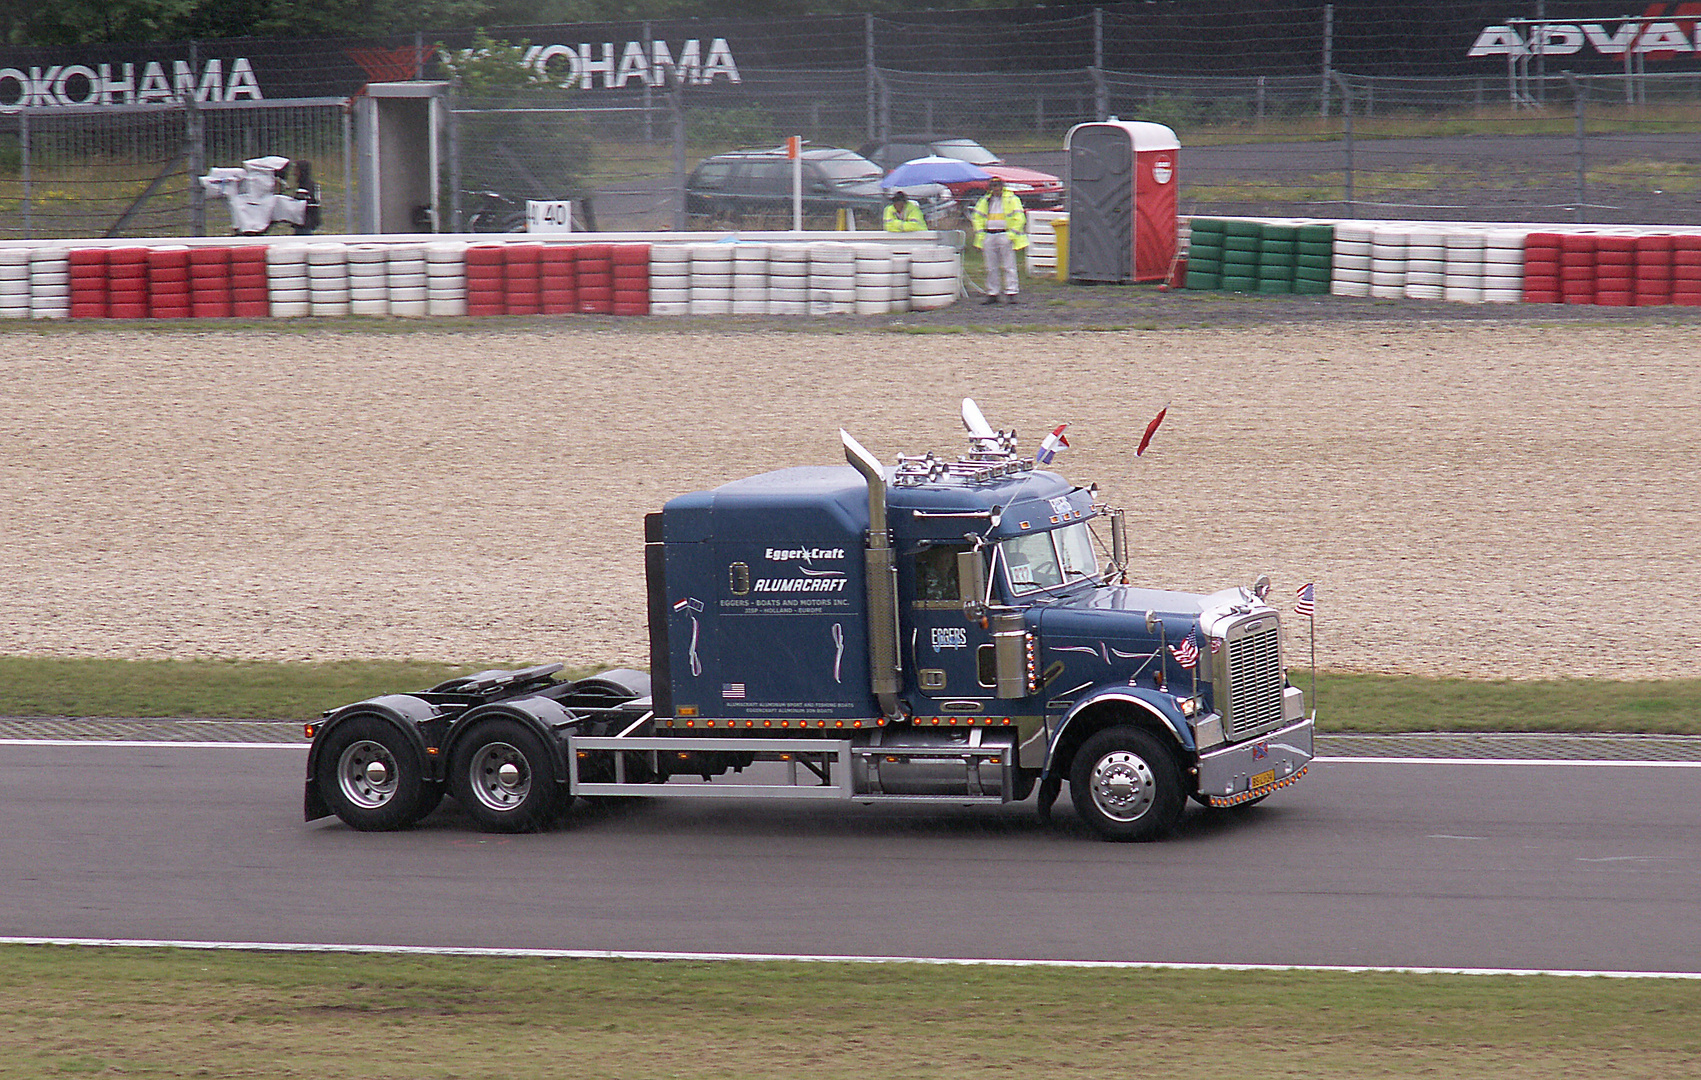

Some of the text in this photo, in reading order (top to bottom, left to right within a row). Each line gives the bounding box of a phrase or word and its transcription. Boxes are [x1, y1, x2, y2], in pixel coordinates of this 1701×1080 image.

[1466, 22, 1701, 56] ADVA
[544, 204, 566, 226] 40
[753, 579, 848, 592] ALUMACRAFT
[720, 599, 749, 607] EGGERS
[833, 598, 850, 606] INC.
[931, 627, 967, 645] EGGERS
